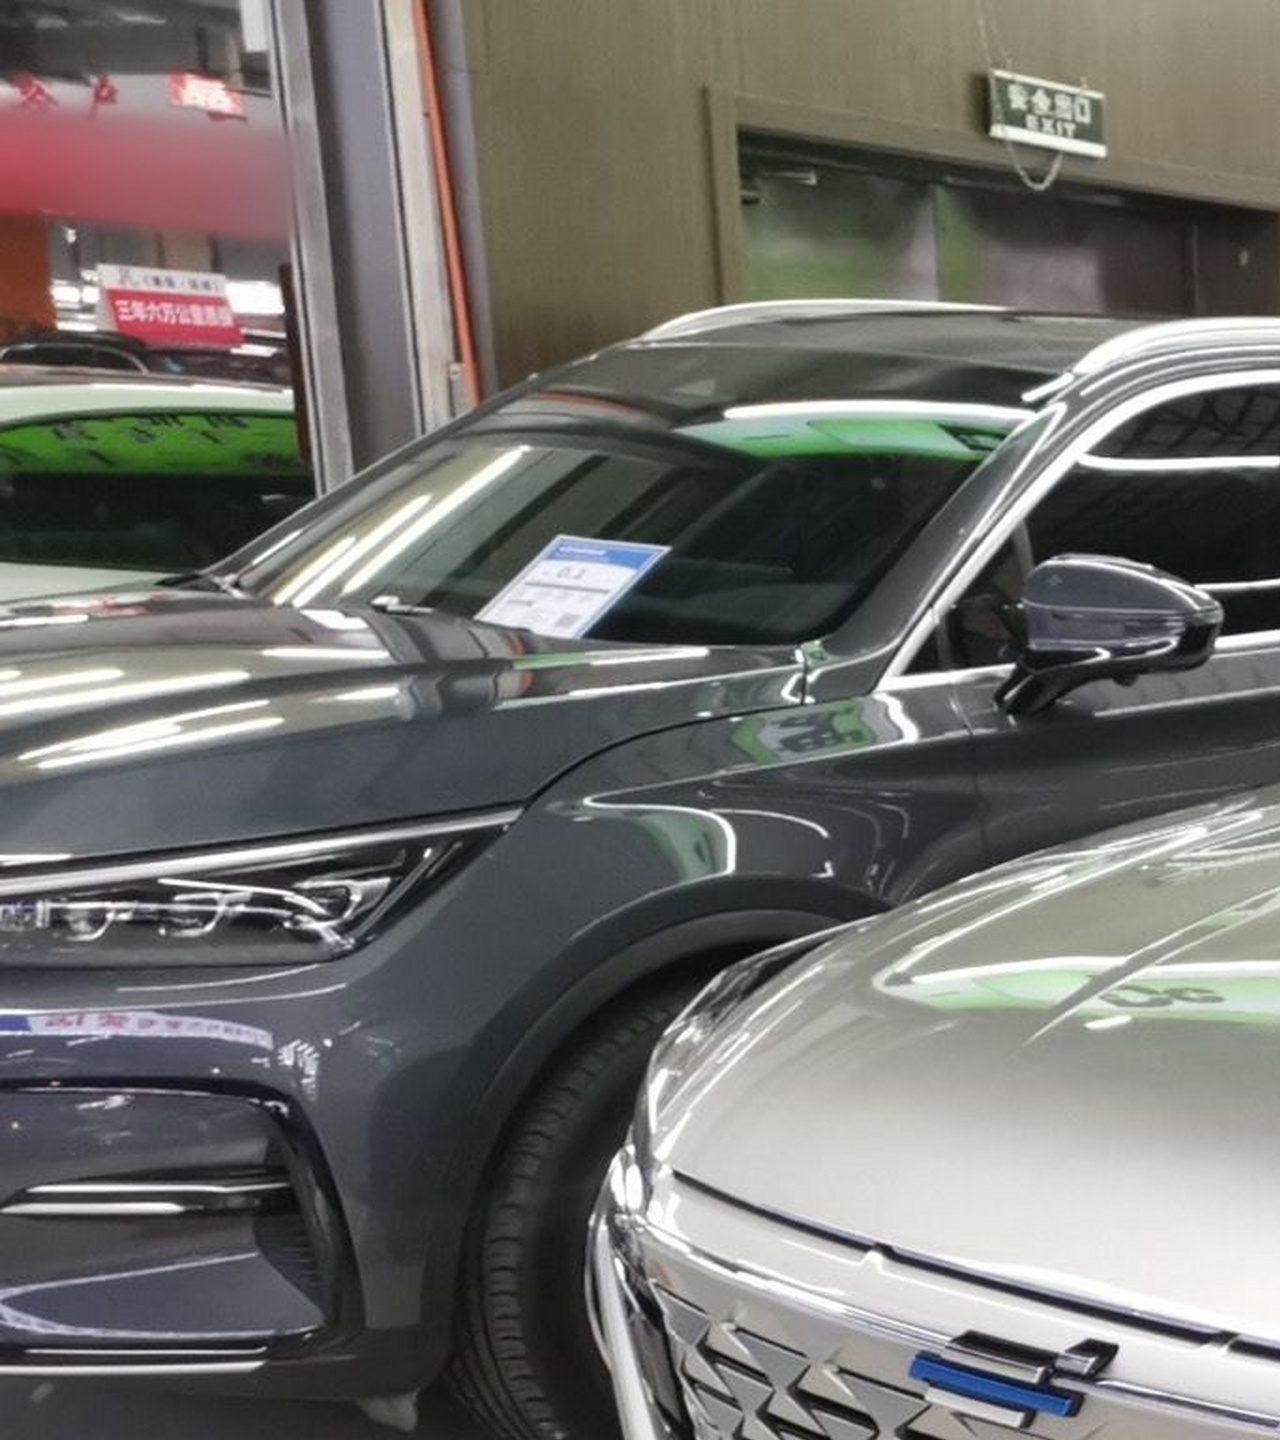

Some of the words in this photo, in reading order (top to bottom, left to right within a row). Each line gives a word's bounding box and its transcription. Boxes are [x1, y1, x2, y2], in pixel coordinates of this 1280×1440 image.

[1007, 83, 1092, 125] 安全出口
[1025, 113, 1076, 139] EXIT
